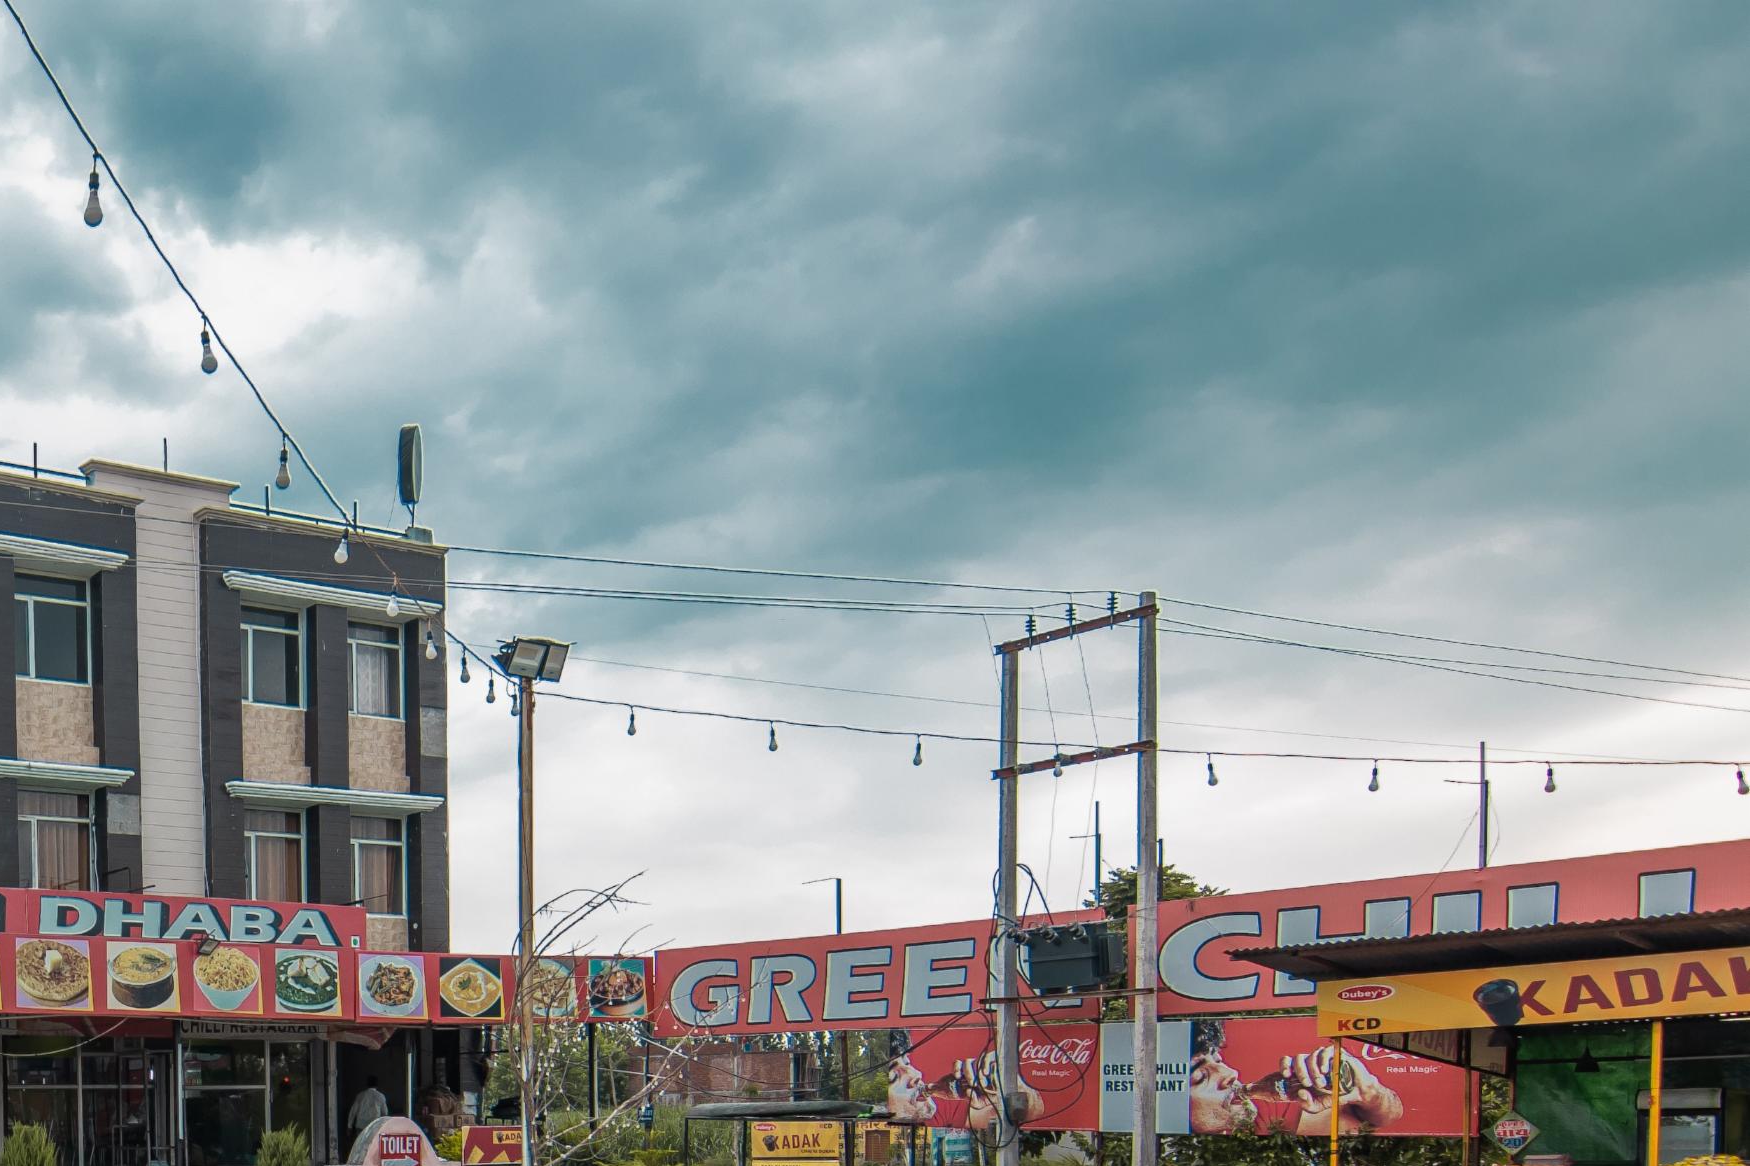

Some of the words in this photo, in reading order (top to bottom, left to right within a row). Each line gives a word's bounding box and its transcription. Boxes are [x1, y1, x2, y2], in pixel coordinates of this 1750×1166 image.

[38, 895, 343, 946] DHABA
[1342, 987, 1388, 1000] Dubey's
[231, 1022, 320, 1034] RESTAURAN
[1338, 1017, 1381, 1032] KCD
[1032, 1069, 1048, 1077] Real
[1049, 1069, 1071, 1078] Magic
[1103, 1064, 1134, 1076] GREE
[1155, 1063, 1187, 1075] HILLI
[1386, 1065, 1406, 1074] Real
[1409, 1065, 1438, 1075] Magic
[1105, 1080, 1185, 1092] RESTANT
[501, 1131, 522, 1142] KADA
[772, 1133, 821, 1150] KADAK
[382, 1136, 420, 1154] TOILET
